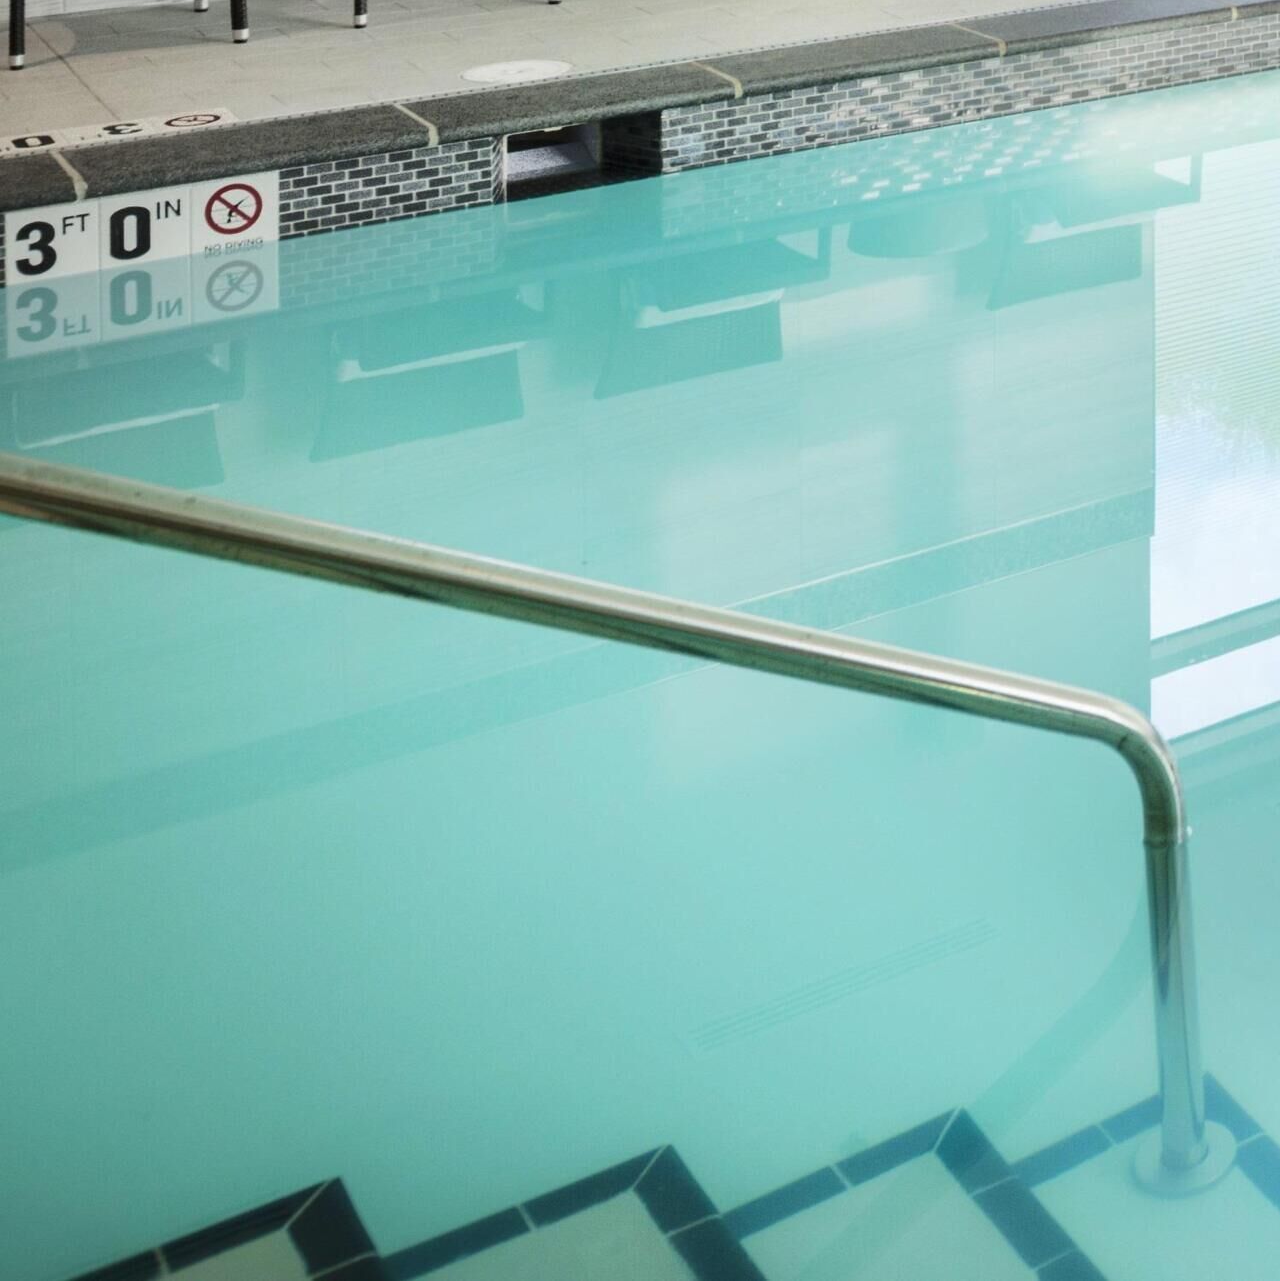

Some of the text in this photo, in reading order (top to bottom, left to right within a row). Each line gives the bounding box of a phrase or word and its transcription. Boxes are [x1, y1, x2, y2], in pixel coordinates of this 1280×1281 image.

[16, 199, 181, 275] 3 FT 0 IN
